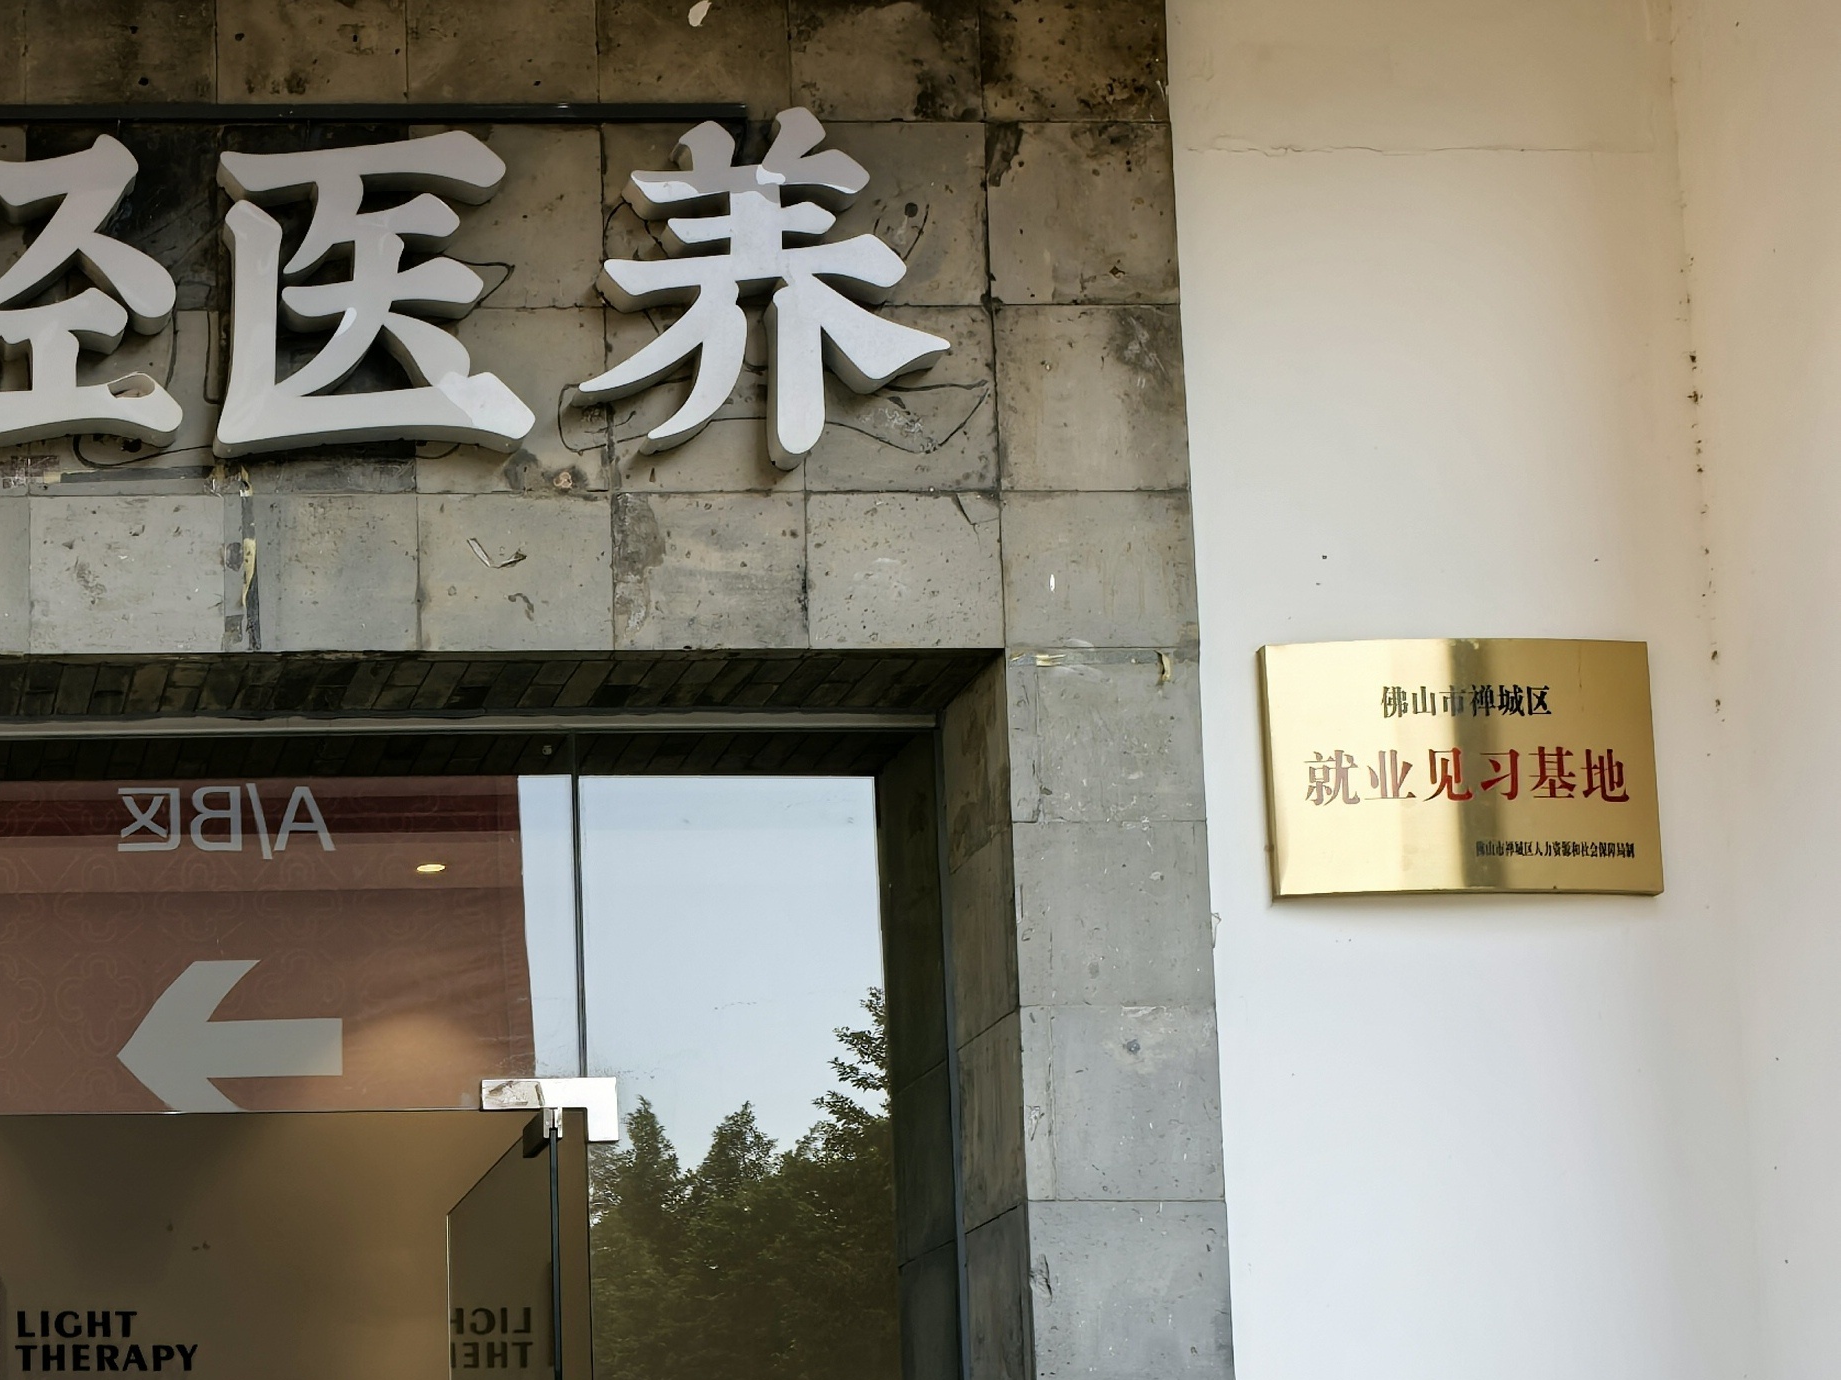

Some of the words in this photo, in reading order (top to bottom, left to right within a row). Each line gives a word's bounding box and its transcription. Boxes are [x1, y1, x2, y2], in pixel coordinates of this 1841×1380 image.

[1381, 684, 1552, 718] 佛山市禅城区
[1304, 746, 1630, 806] 就业见习基地
[16, 1310, 138, 1339] LIGHT
[15, 1344, 199, 1372] THERAPY
